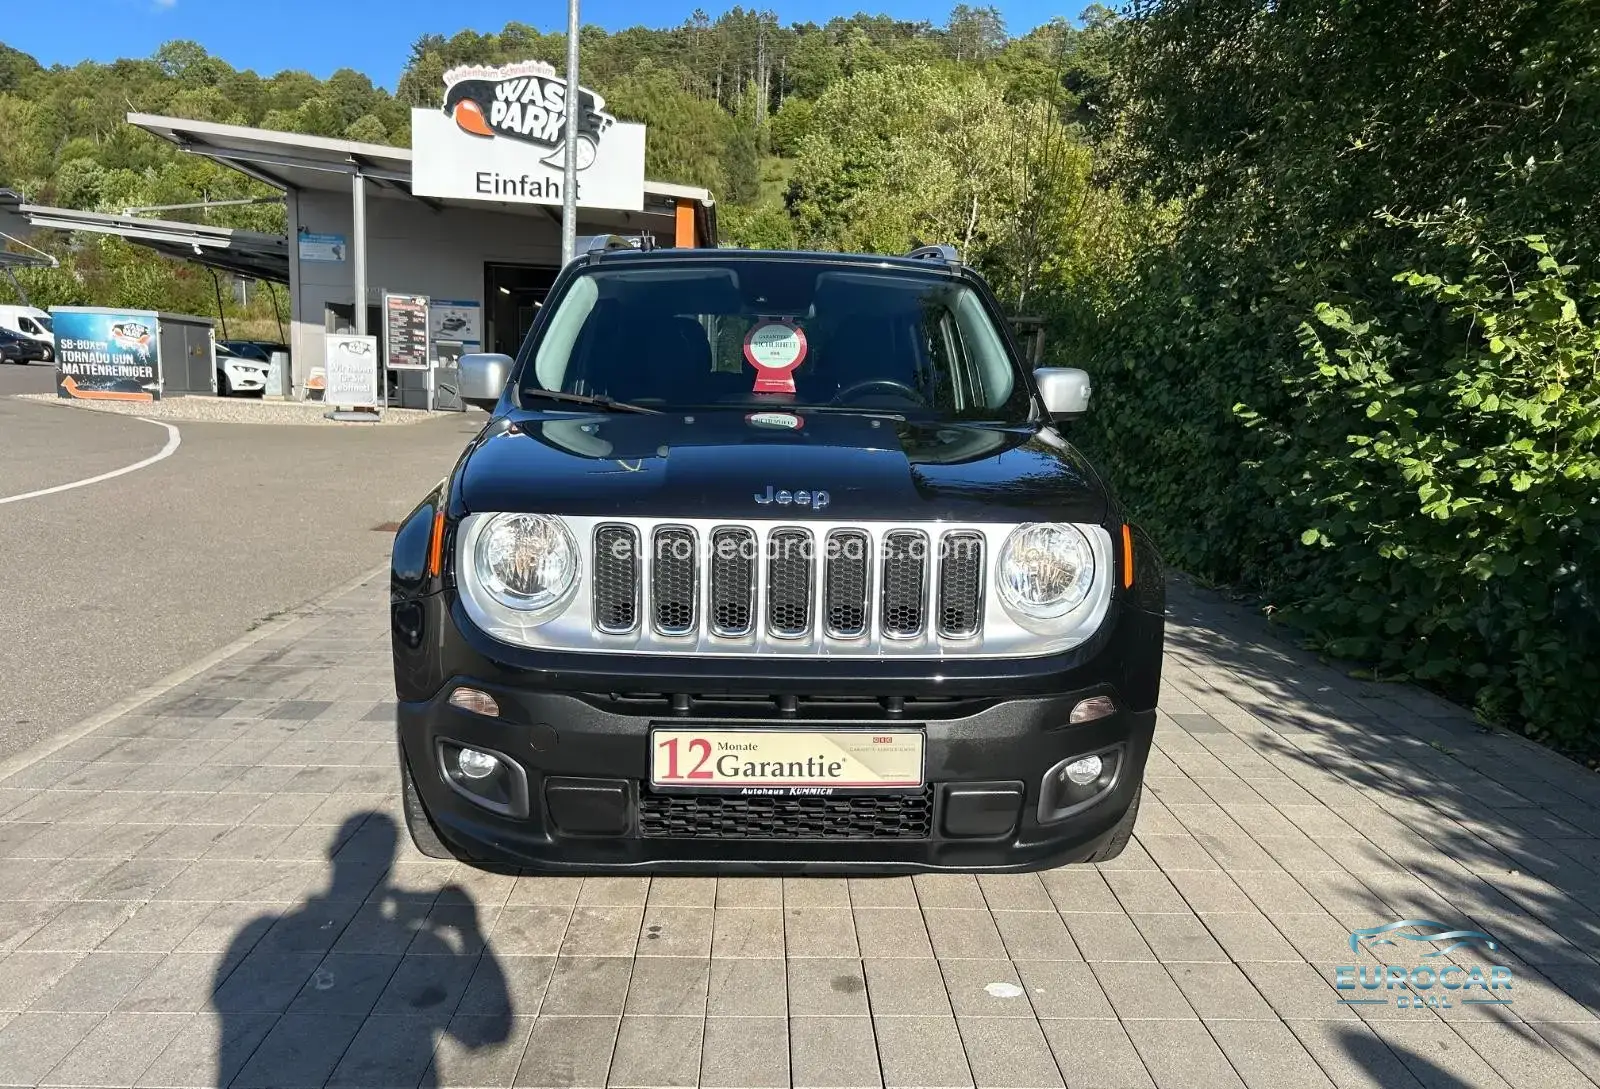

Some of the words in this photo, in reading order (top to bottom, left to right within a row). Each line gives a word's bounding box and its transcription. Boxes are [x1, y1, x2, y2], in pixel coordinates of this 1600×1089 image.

[446, 68, 498, 85] Heidenheim
[500, 65, 553, 78] Schnaitheim
[495, 78, 567, 116] WAS
[490, 100, 567, 142] PARK
[475, 171, 581, 200] Einfaht
[60, 339, 108, 350] SB-BOXEN
[60, 350, 110, 363] TORNADO
[62, 362, 153, 378] MATTENREINIGER
[754, 485, 830, 509] Jeep
[658, 737, 714, 779] 12
[717, 741, 758, 751] Monate
[741, 787, 784, 796] Autohaus
